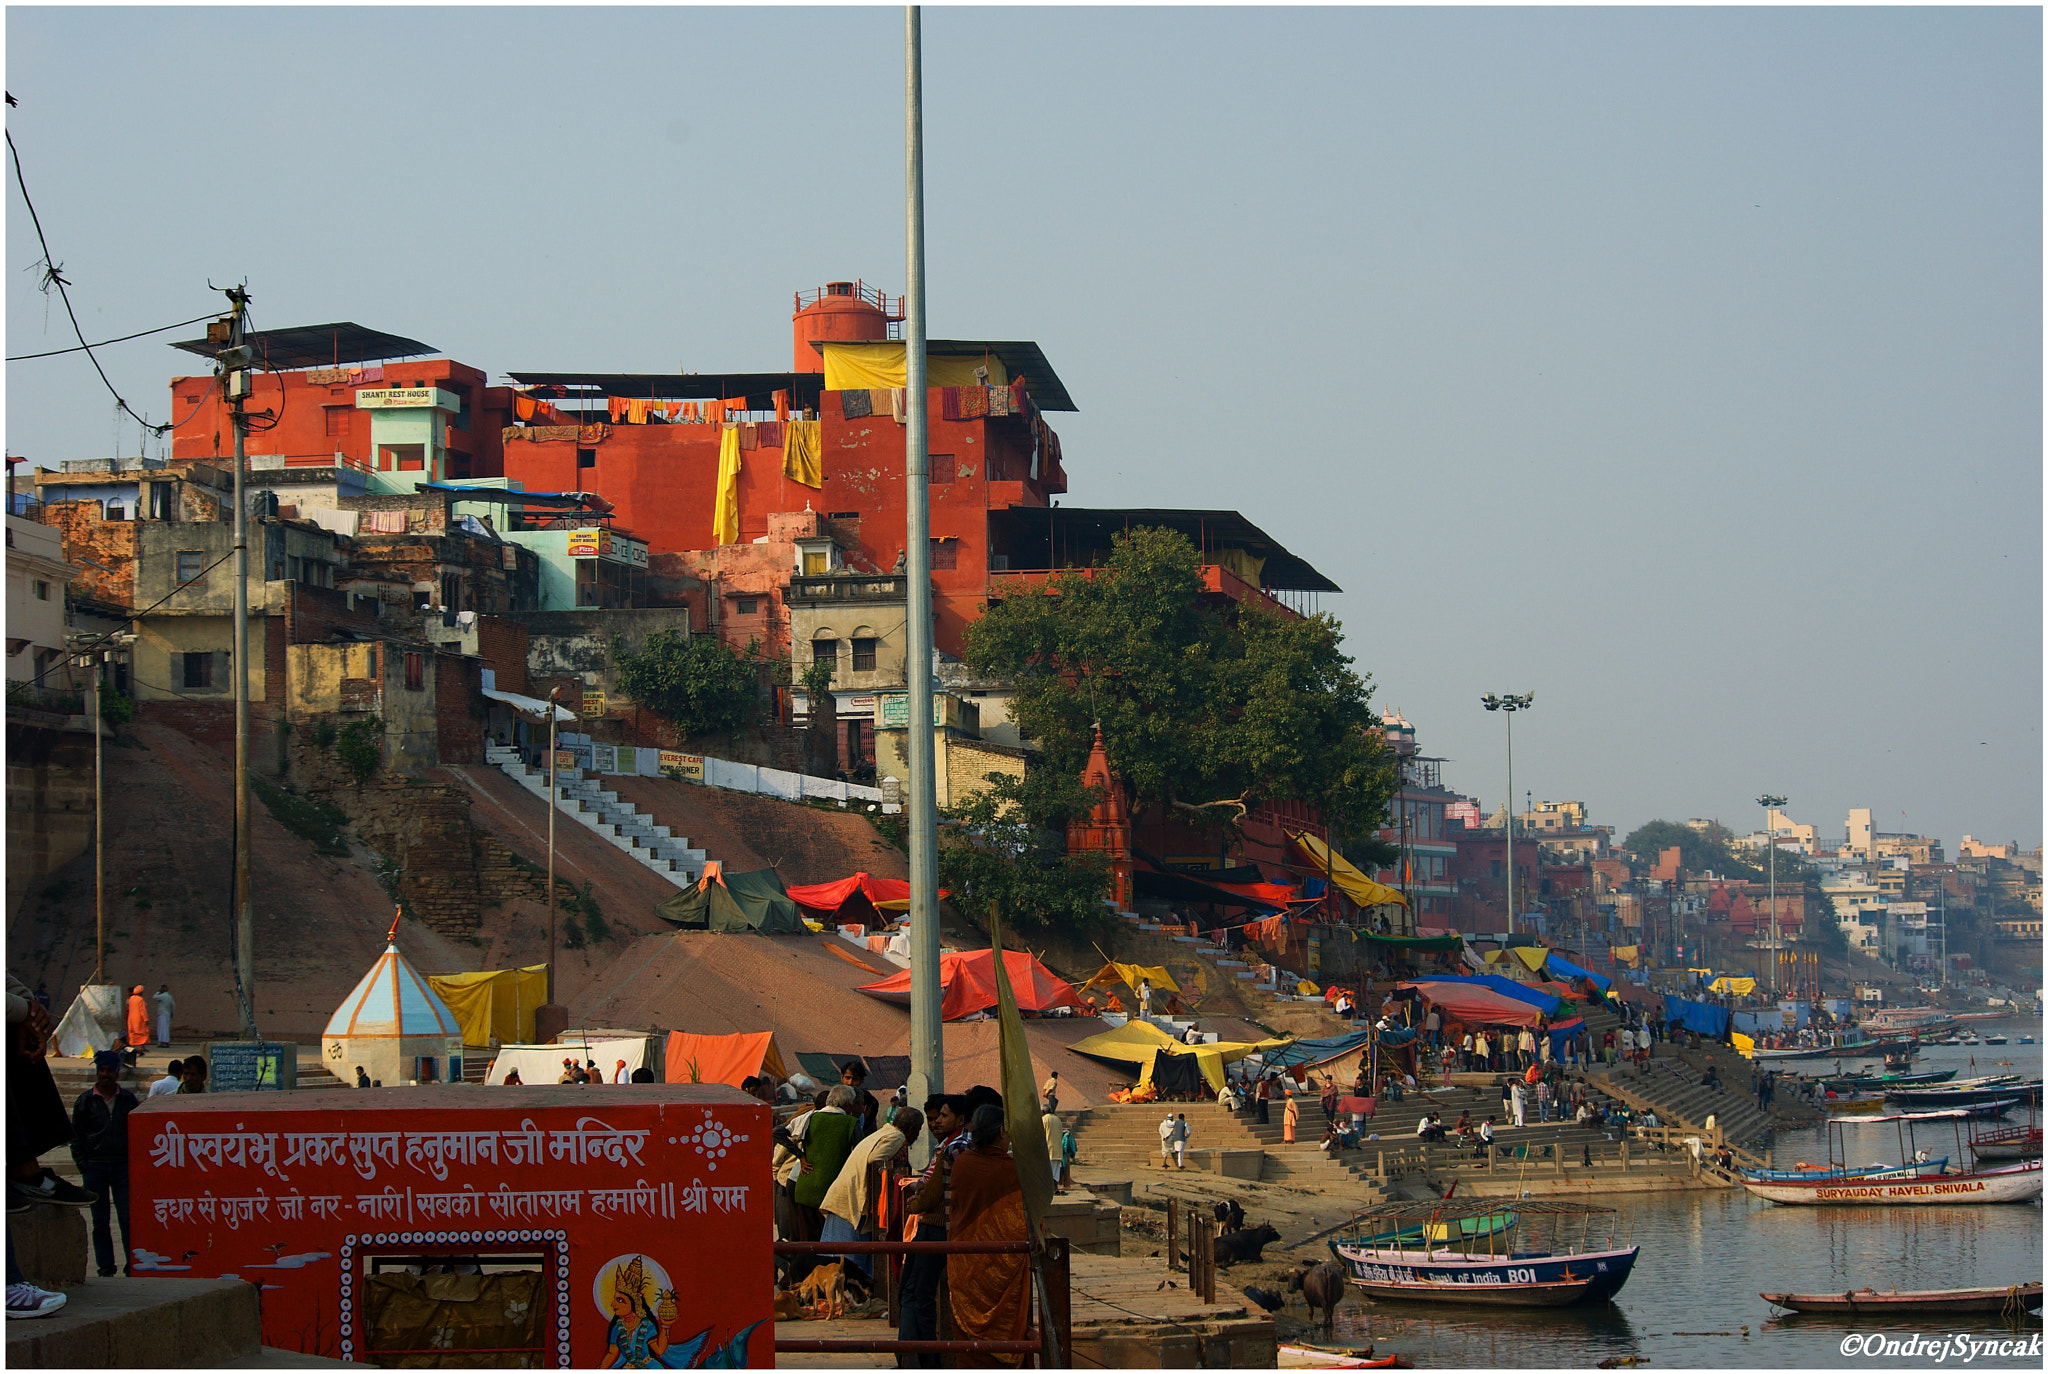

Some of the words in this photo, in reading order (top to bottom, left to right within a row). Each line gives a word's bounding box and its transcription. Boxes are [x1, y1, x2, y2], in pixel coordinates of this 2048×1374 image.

[361, 390, 386, 399] SHANTI
[388, 390, 406, 398] REST
[407, 389, 430, 398] HOUSE
[660, 753, 687, 763] EVEREST
[687, 756, 704, 764] CAFE
[150, 1121, 186, 1168] श्री
[283, 1131, 347, 1167] प्रकट
[348, 1131, 402, 1180] सुप्त
[403, 1130, 501, 1181] हनुमान
[501, 1118, 546, 1165] जी
[548, 1116, 651, 1168] मन्दिर
[1815, 1186, 1885, 1199] SURYAUDAY
[1934, 1180, 1986, 1195] SHIVALA
[197, 1190, 218, 1223] से
[220, 1187, 272, 1231] गुजरे
[275, 1187, 305, 1221] जो
[309, 1195, 343, 1222] नर
[415, 1183, 486, 1222] सबको
[488, 1182, 586, 1224] सीताराम
[680, 1177, 709, 1215] श्री
[710, 1185, 751, 1215] राम
[1472, 1272, 1501, 1284] India
[1507, 1268, 1537, 1284] BOI
